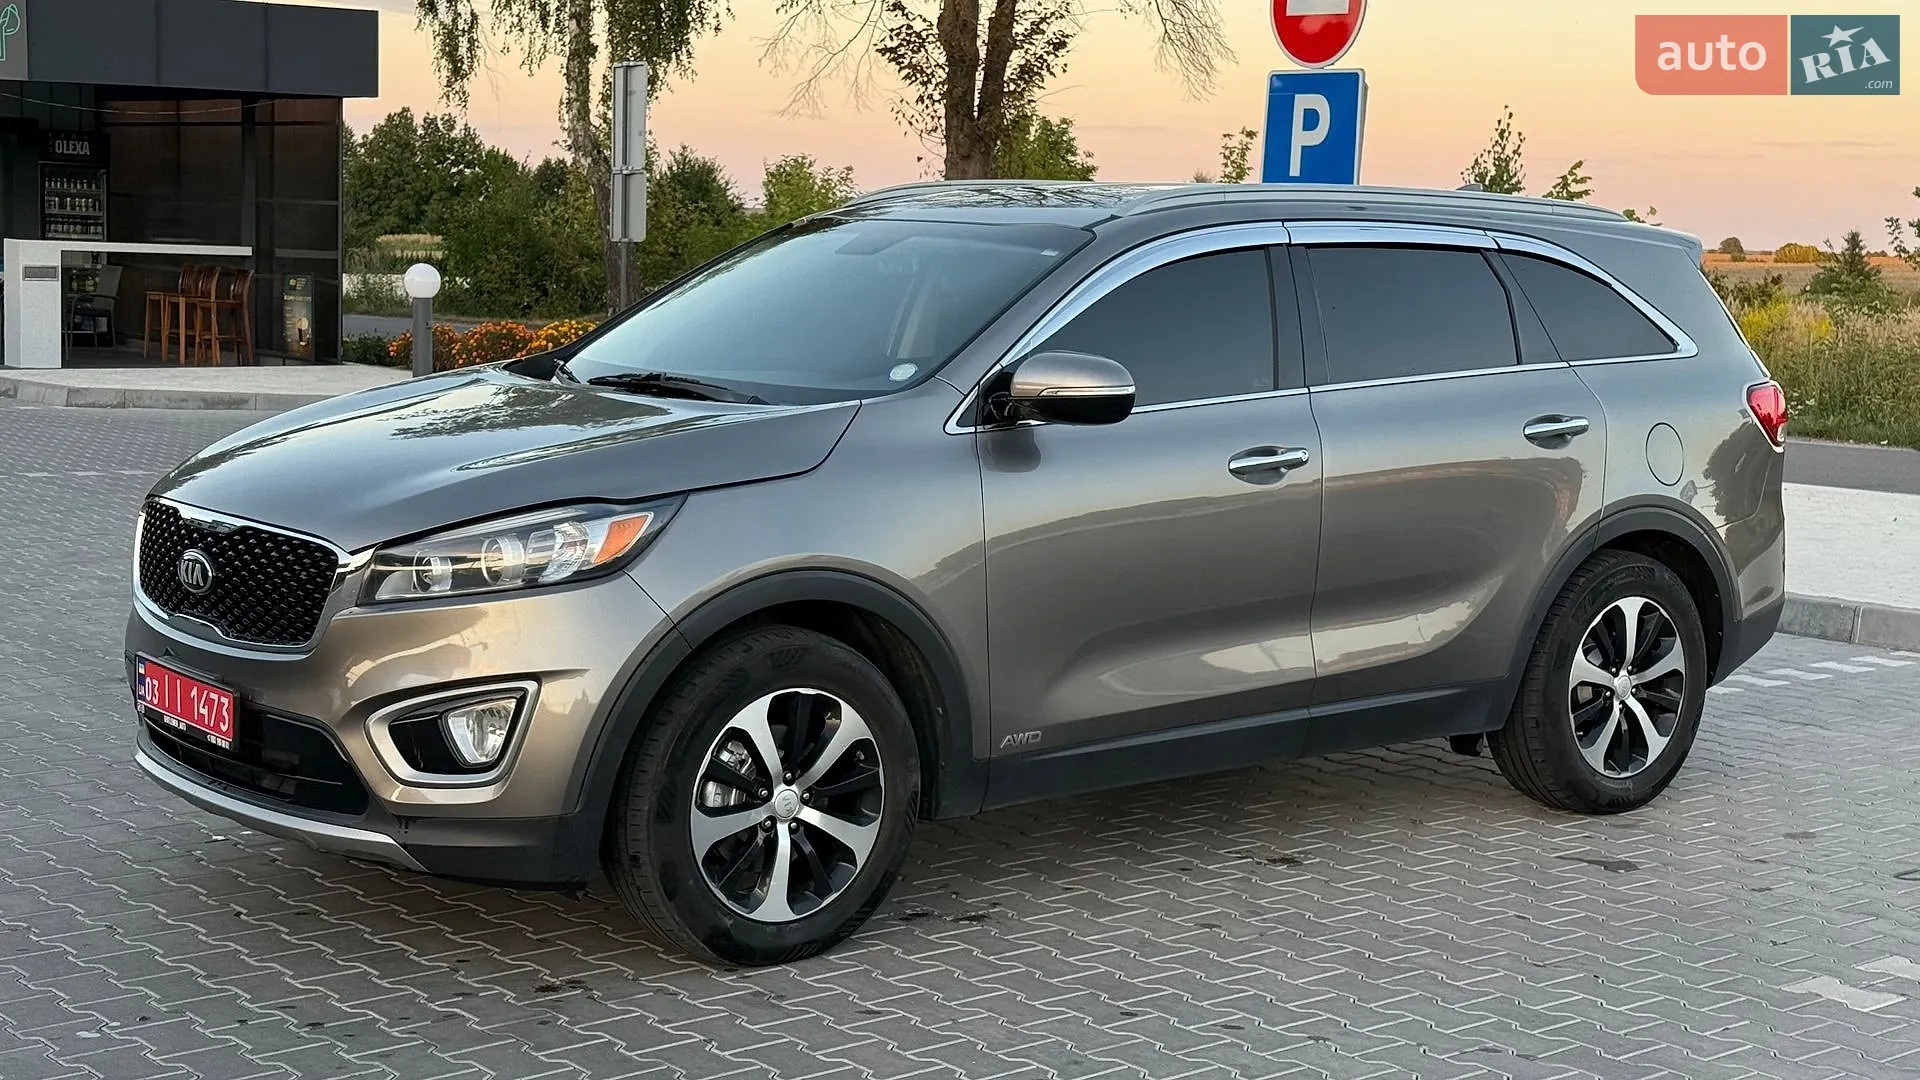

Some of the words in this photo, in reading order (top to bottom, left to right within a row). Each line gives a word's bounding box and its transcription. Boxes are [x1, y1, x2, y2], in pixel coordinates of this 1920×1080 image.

[1289, 93, 1331, 177] P
[180, 559, 204, 586] KIA
[145, 676, 159, 705] 03
[190, 685, 230, 733] 1473
[1000, 730, 1042, 748] AWD
